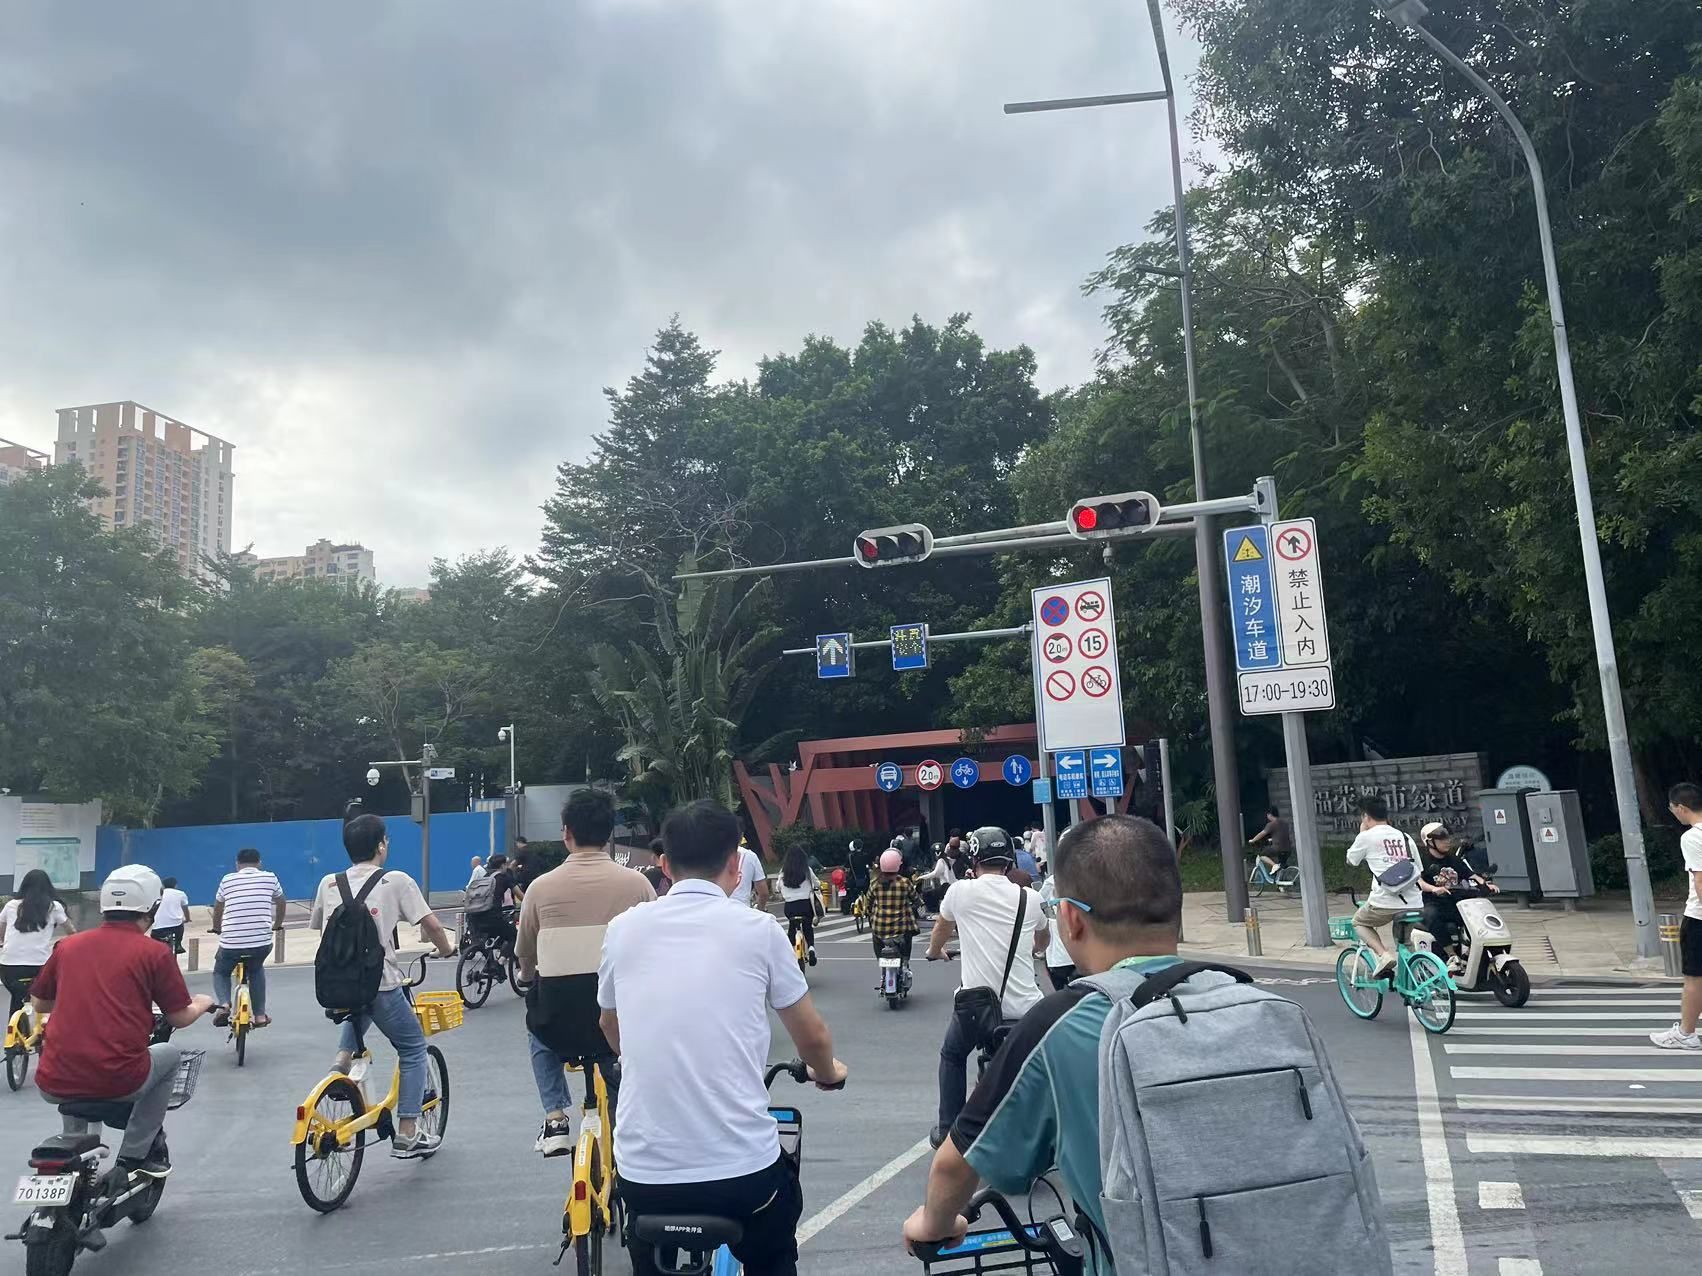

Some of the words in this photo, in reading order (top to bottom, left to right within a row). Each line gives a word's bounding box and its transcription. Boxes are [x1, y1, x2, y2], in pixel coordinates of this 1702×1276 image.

[1241, 574, 1269, 662] 潮汐车道
[1288, 568, 1316, 657] 禁止入内
[1084, 635, 1102, 652] 15
[1244, 678, 1329, 703] 17:00-19:30
[18, 1187, 67, 1200] 70138P
